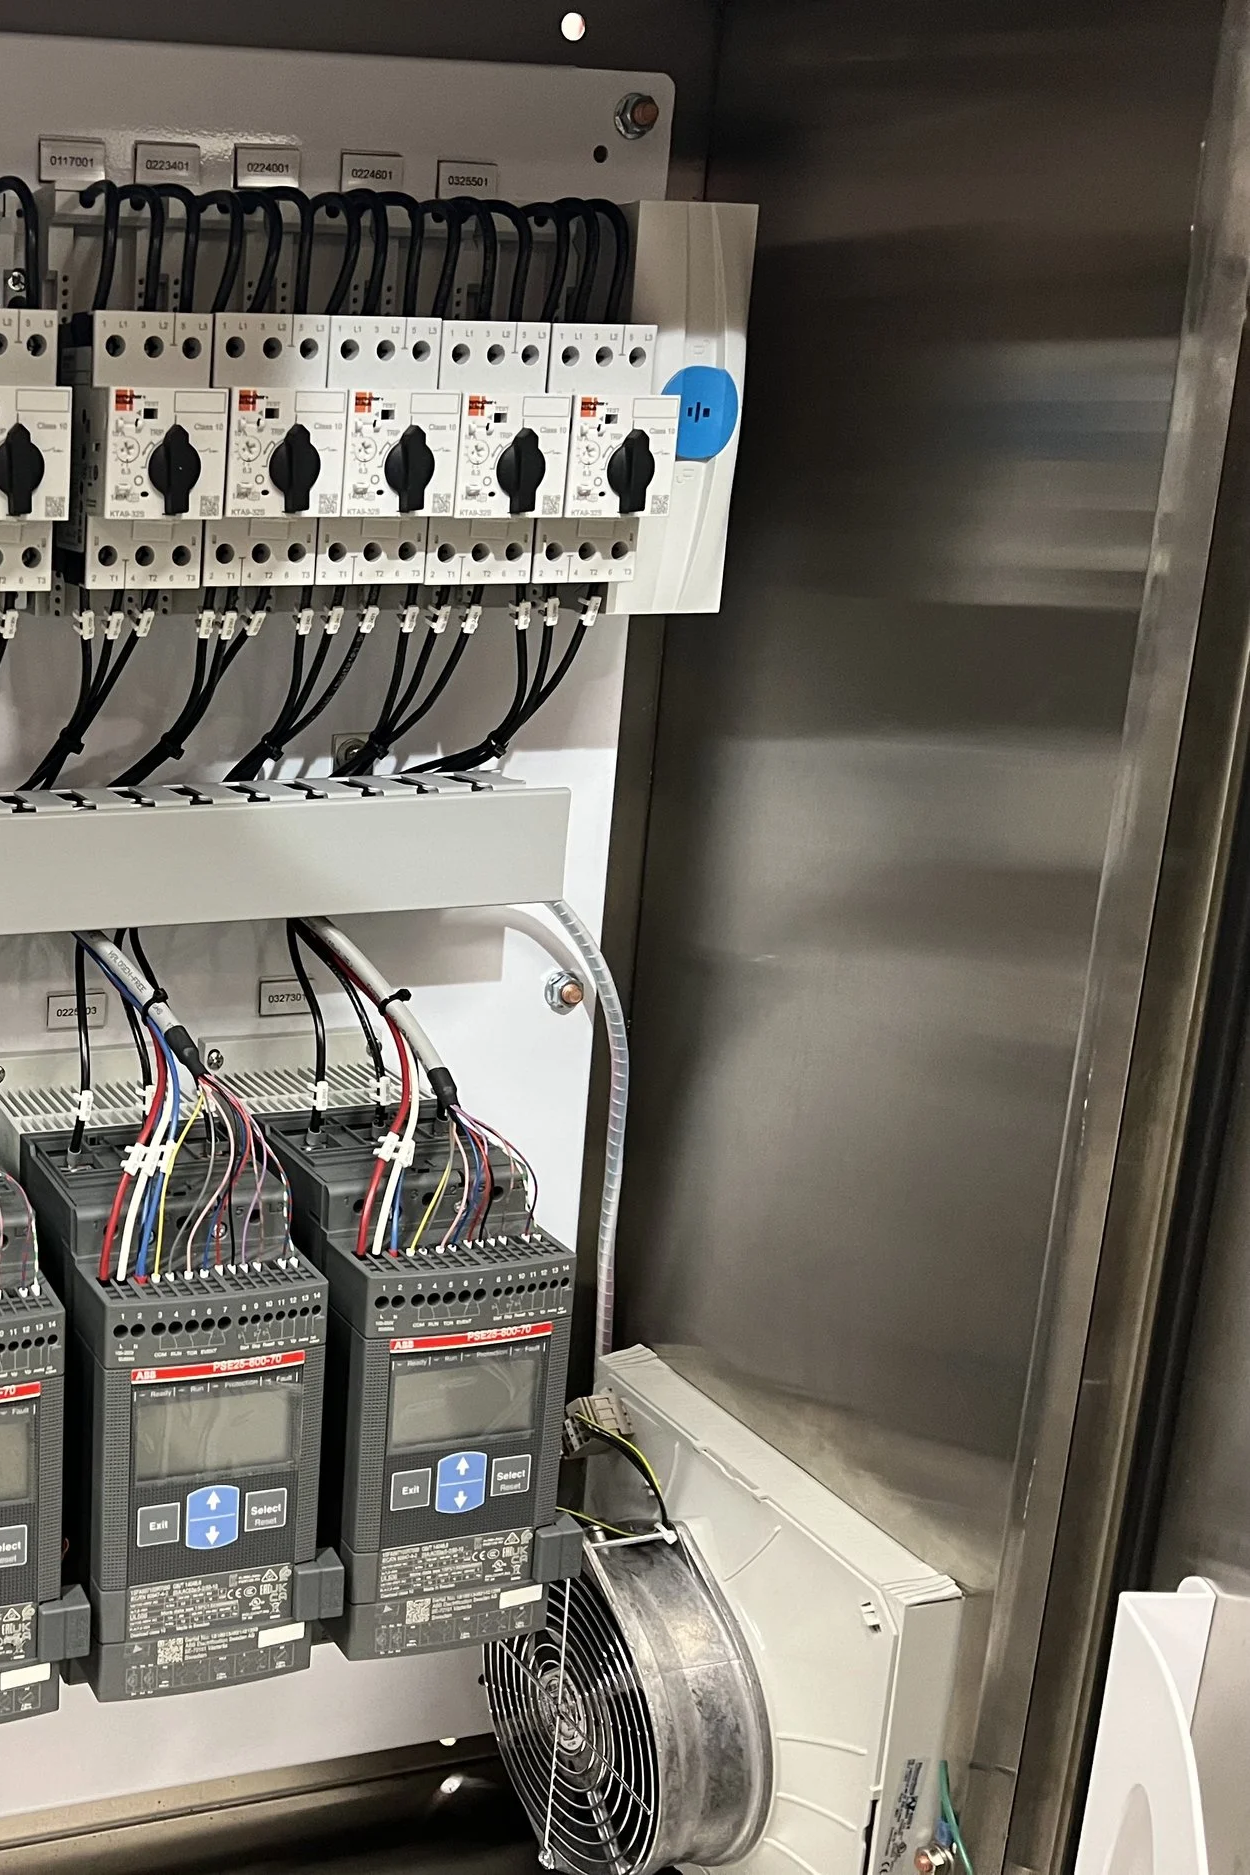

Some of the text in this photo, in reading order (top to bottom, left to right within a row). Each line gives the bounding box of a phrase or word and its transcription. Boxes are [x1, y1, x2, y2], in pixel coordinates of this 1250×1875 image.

[50, 155, 94, 168] 0117001
[145, 160, 189, 171] 0223401
[246, 162, 289, 173] 0224001
[352, 169, 392, 180] 0224601
[149, 574, 157, 582] T2
[56, 1006, 97, 1017] 022503
[10, 1328, 17, 1336] 11
[394, 1341, 414, 1350] ABB
[525, 1344, 540, 1353] Fault
[136, 1371, 156, 1380] ABB
[190, 1385, 204, 1393] Run
[12, 1406, 29, 1415] Fault
[402, 1469, 525, 1495] Exit Select
[499, 1482, 521, 1491] Reset
[149, 1504, 281, 1530] Exit Select
[254, 1517, 277, 1526] Reset
